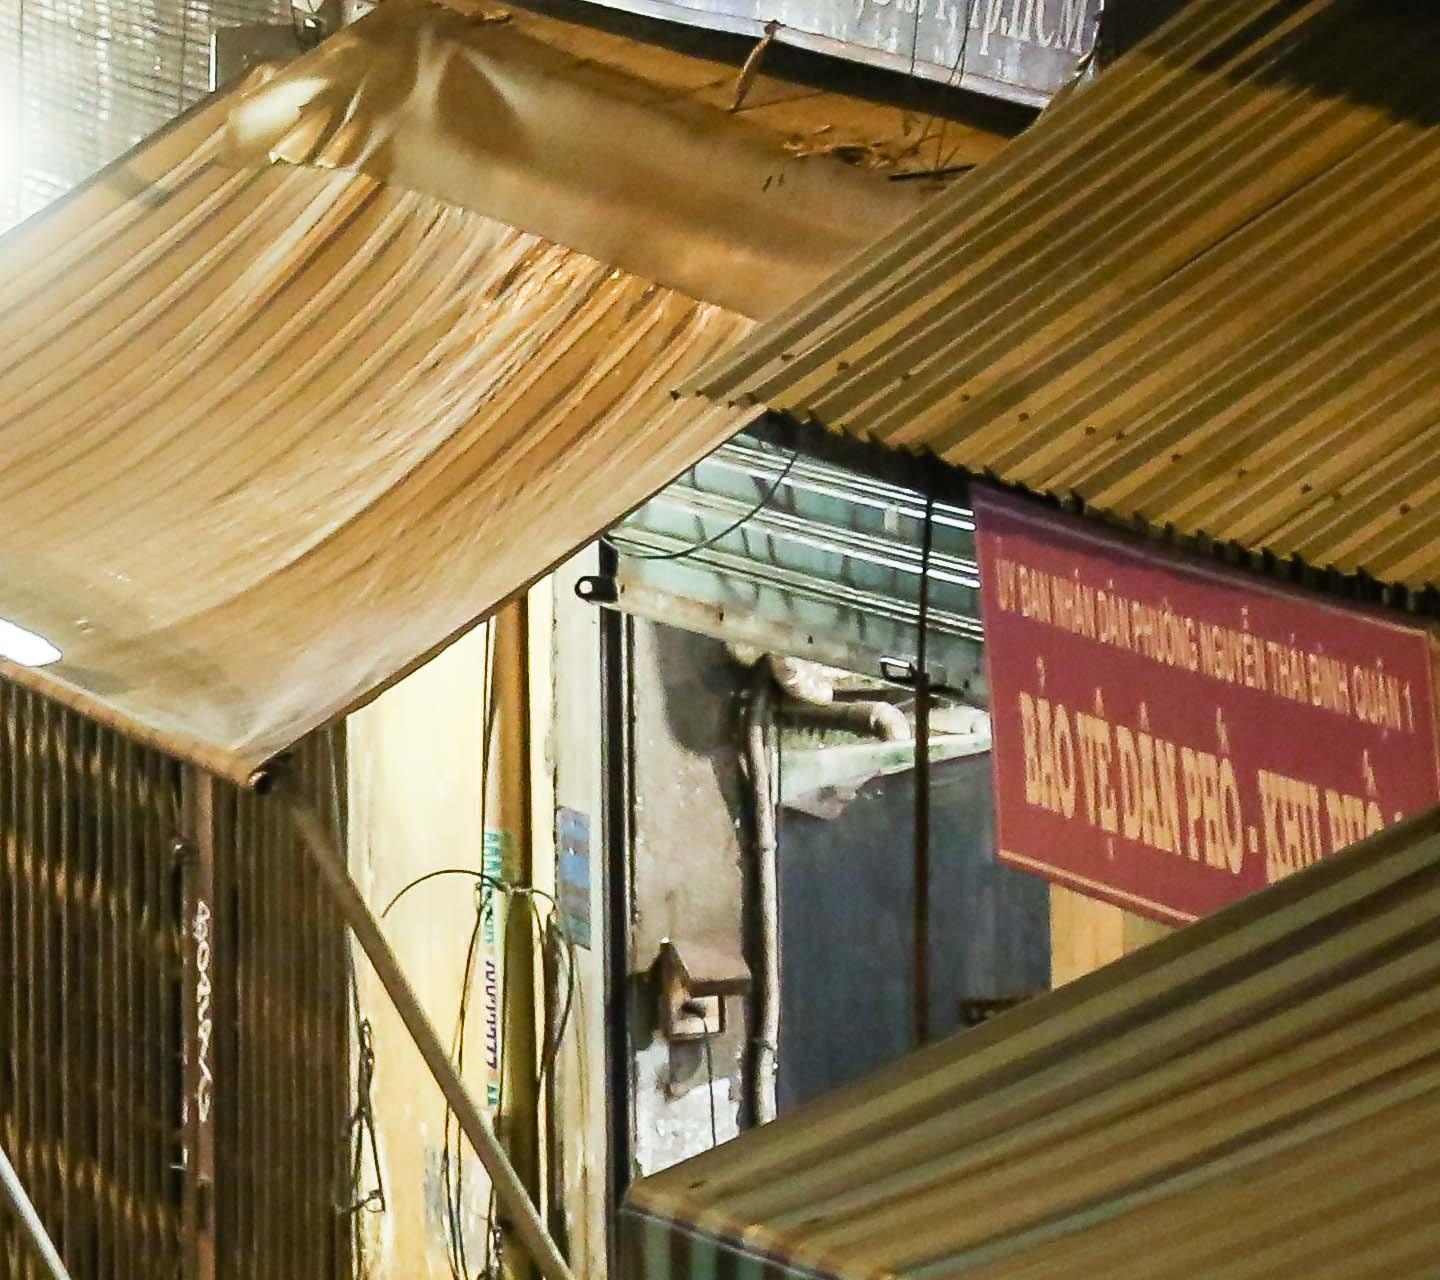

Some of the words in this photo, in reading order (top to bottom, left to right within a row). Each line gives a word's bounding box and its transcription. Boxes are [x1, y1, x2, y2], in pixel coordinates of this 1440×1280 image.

[1018, 564, 1051, 623] BAN
[1019, 655, 1076, 819] BẢO
[1077, 687, 1118, 861] VỆ
[1117, 701, 1182, 855] DÂN
[1181, 708, 1243, 875] PHỐ
